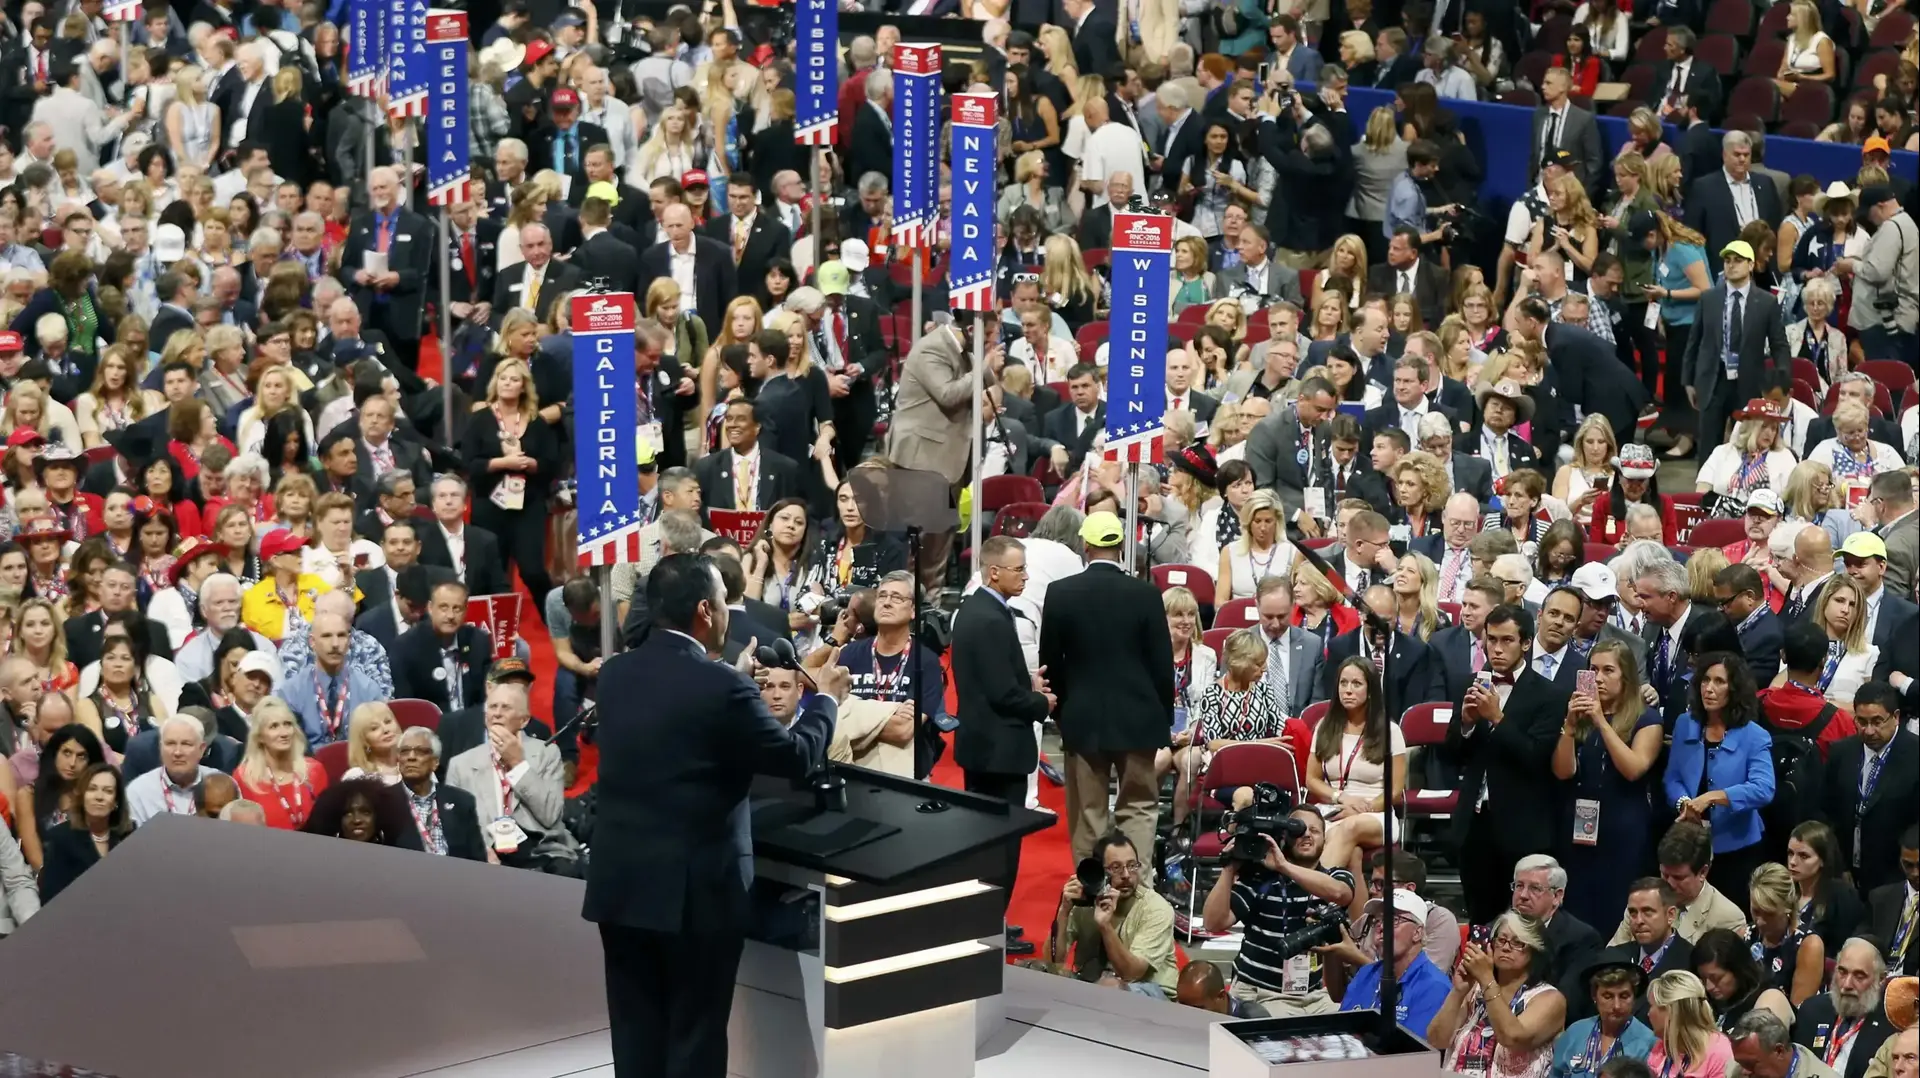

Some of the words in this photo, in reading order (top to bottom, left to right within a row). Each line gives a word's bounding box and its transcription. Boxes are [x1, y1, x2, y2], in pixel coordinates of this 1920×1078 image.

[357, 9, 367, 65] DAKOTA
[810, 0, 825, 109] MISSOURI
[441, 48, 456, 162] GEORGIA
[904, 78, 913, 208] MASSACHUSETTS
[928, 78, 936, 207] MASSACHUSETTS
[963, 136, 980, 261] NEVADA
[1129, 259, 1151, 412] WISCONSIN
[596, 338, 618, 514] CALIFORNIA
[1688, 516, 1706, 527] MA
[497, 620, 508, 648] MAKE
